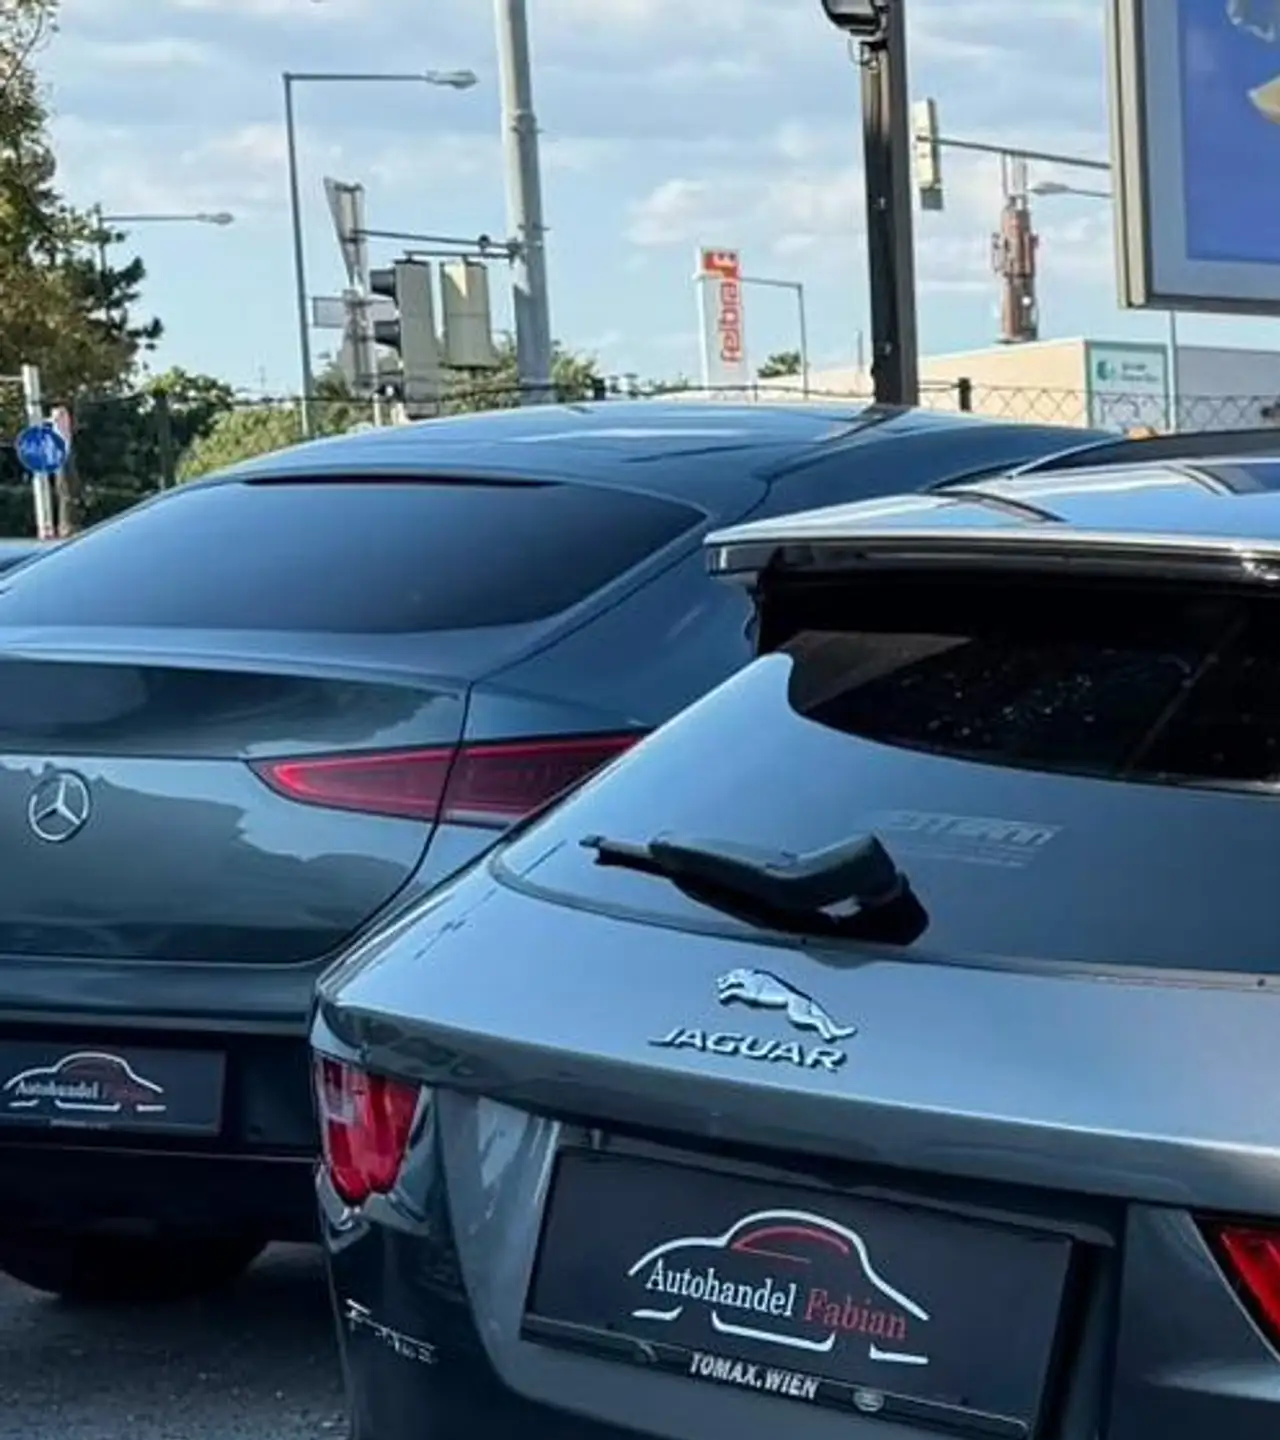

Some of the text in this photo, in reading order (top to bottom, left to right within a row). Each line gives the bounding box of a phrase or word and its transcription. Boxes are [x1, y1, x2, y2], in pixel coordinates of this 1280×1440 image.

[648, 1028, 847, 1073] JAGUAR
[646, 1258, 908, 1340] Autohandel Fabian
[688, 1351, 821, 1400] TOMAX.WIEN
